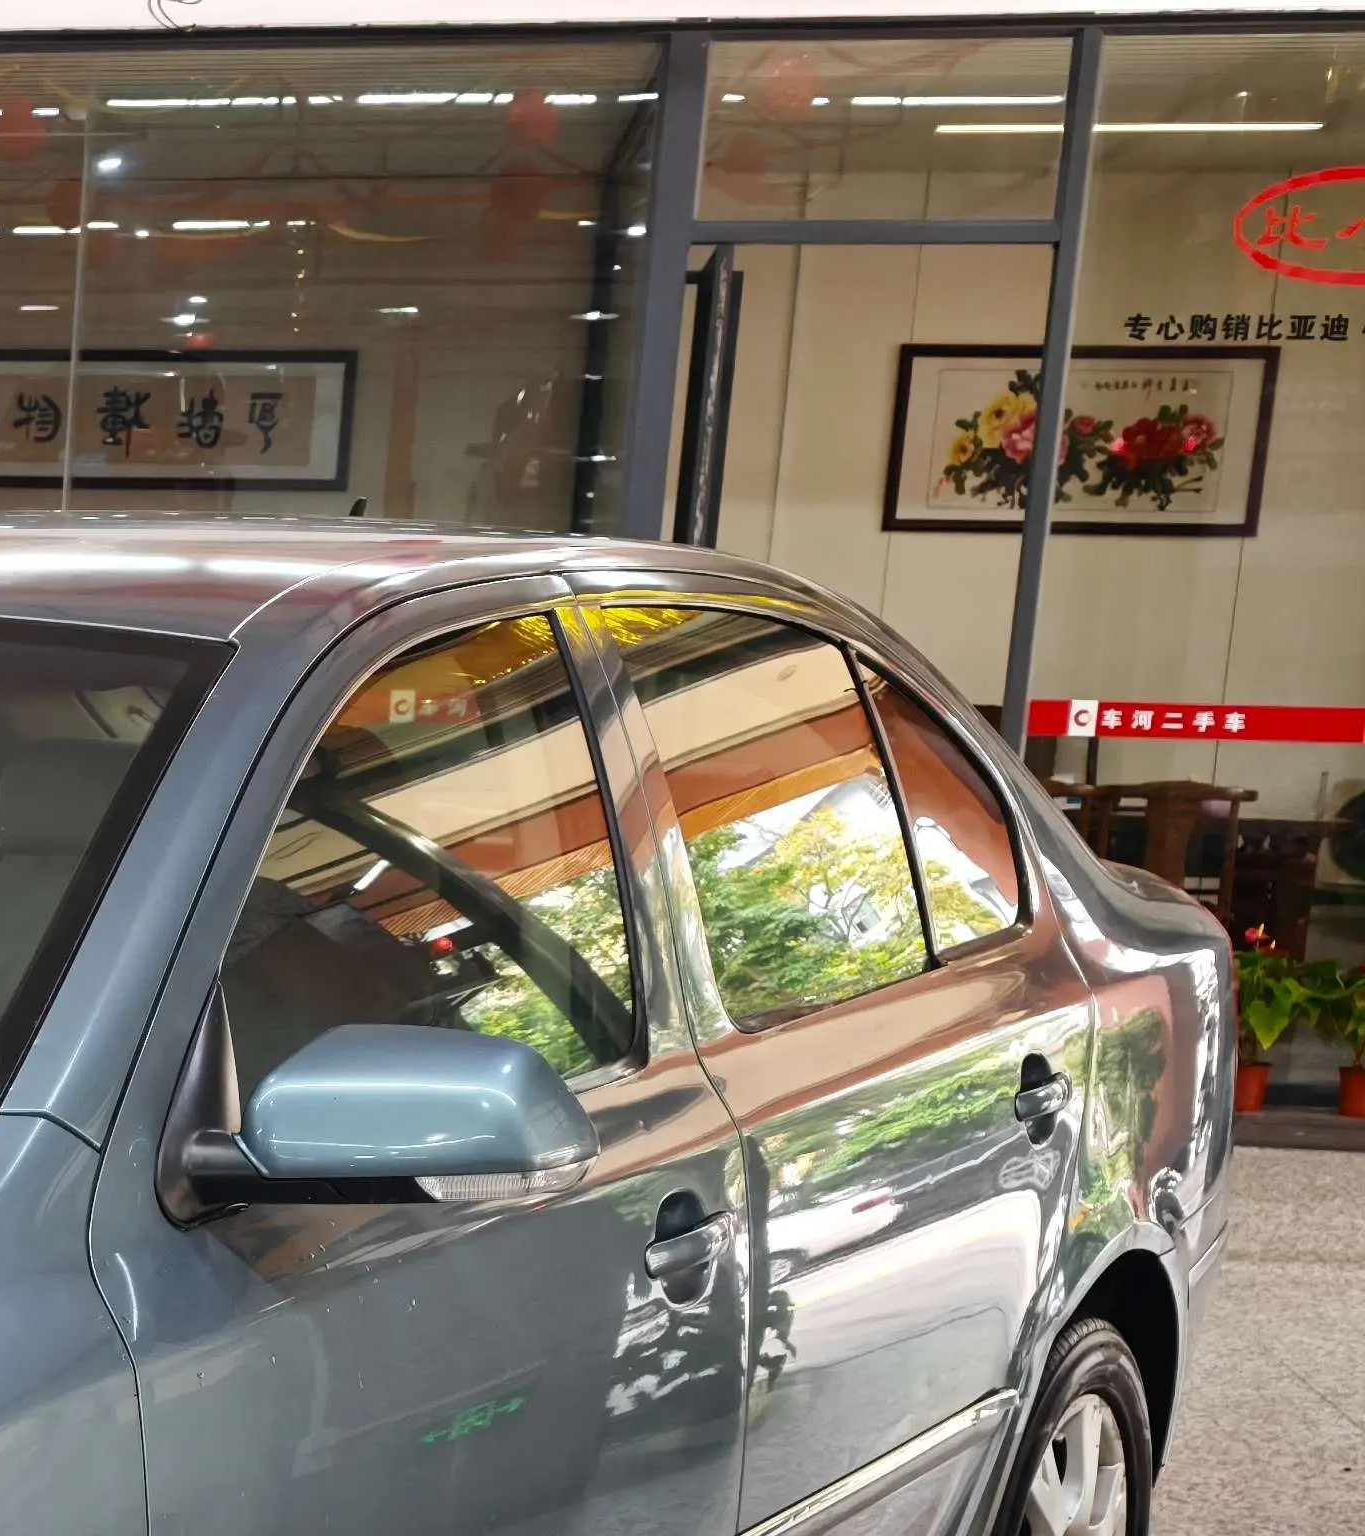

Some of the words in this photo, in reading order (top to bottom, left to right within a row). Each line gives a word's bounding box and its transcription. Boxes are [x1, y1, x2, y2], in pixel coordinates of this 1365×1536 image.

[1124, 314, 1349, 342] 专心购销比亚迪
[1101, 708, 1247, 733] 车河二手车
